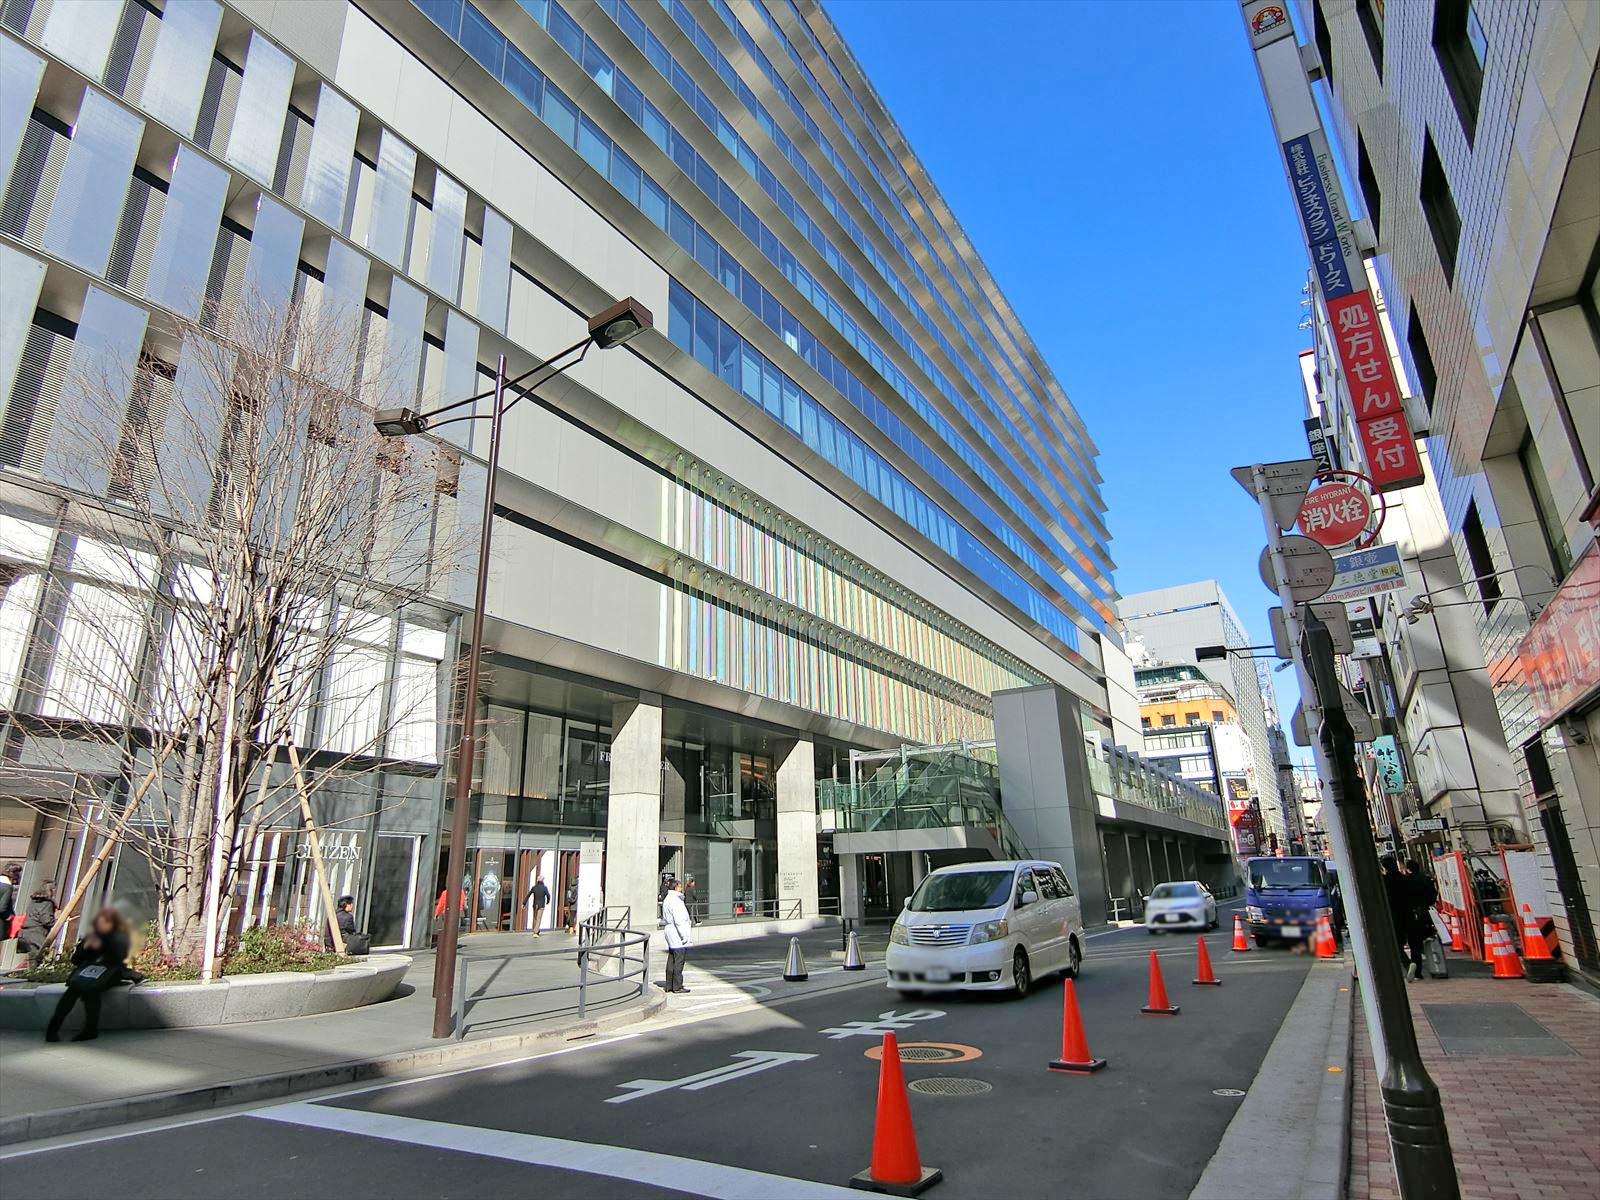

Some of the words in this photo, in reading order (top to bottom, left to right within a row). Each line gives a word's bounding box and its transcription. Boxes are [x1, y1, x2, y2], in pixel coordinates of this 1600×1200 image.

[1316, 153, 1333, 194] Business
[1329, 193, 1344, 223] Grand
[1338, 303, 1405, 471] 処方せん受付
[1304, 494, 1320, 505] FIRE
[1320, 486, 1353, 500] HYDRANT
[1301, 496, 1366, 533] 消火栓
[296, 843, 362, 860] CIIZEN
